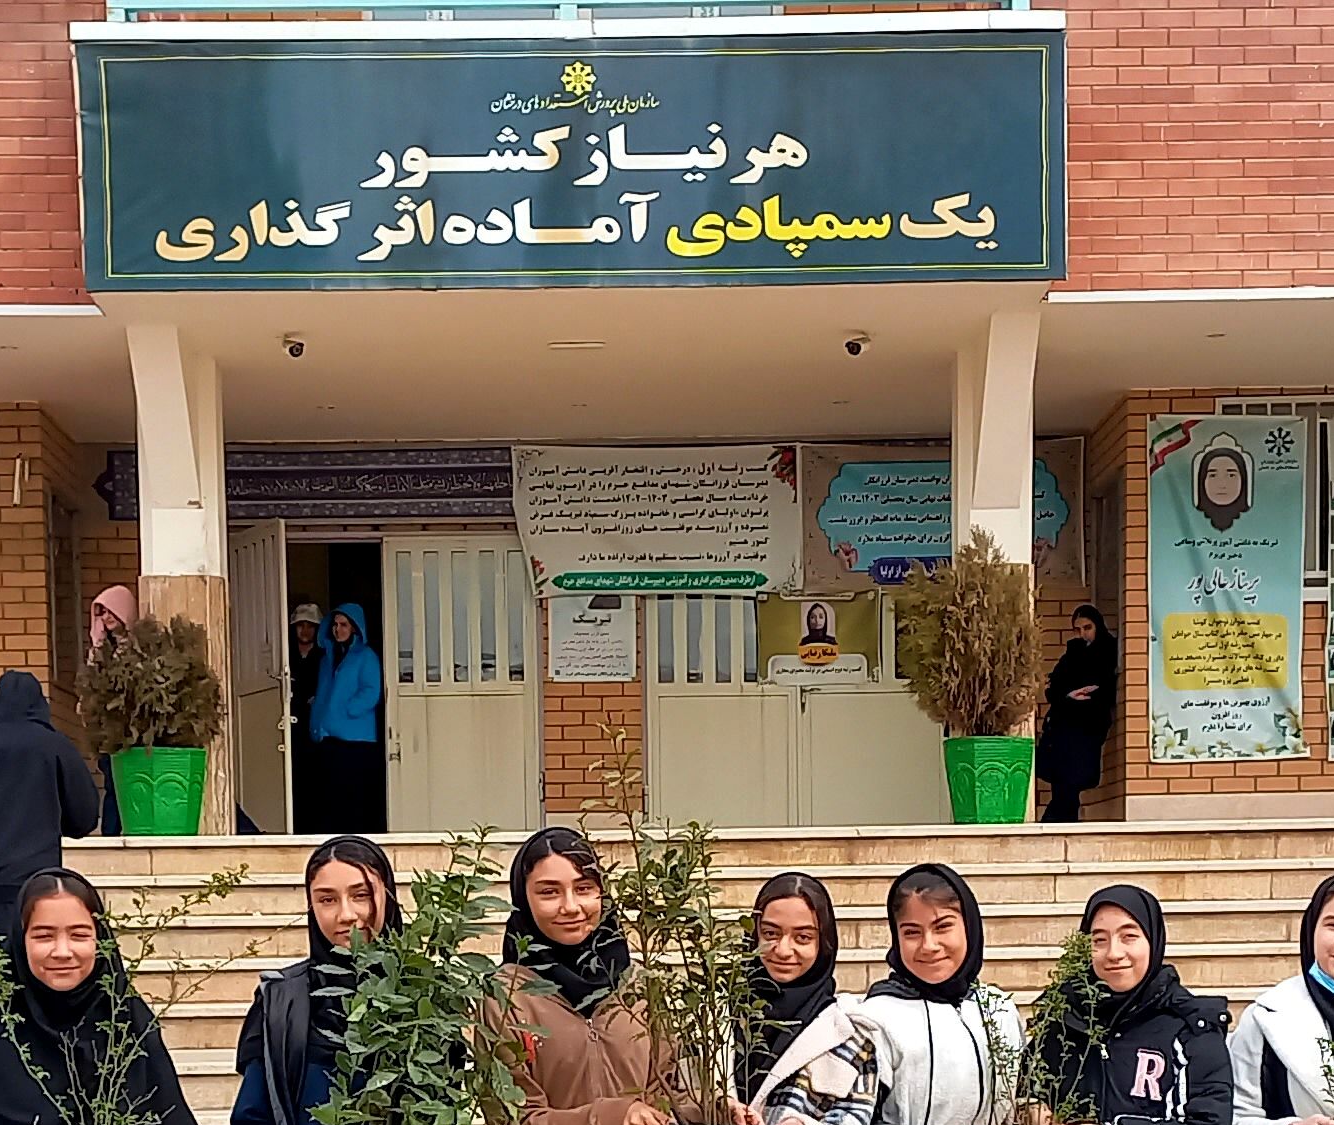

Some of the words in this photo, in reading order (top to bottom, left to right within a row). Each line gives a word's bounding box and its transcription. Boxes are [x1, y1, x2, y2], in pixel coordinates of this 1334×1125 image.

[491, 91, 522, 114] درخشان
[587, 90, 617, 117] پرورش
[628, 92, 660, 113] سازمان
[359, 125, 571, 189] کشور
[573, 123, 728, 186] نیاز
[729, 132, 809, 184] هر
[154, 200, 352, 262] گذاری
[356, 195, 435, 261] اثر
[442, 191, 660, 245] آماده
[665, 195, 895, 260] سمپادی
[898, 194, 999, 250] یک
[1130, 1048, 1166, 1102] R
